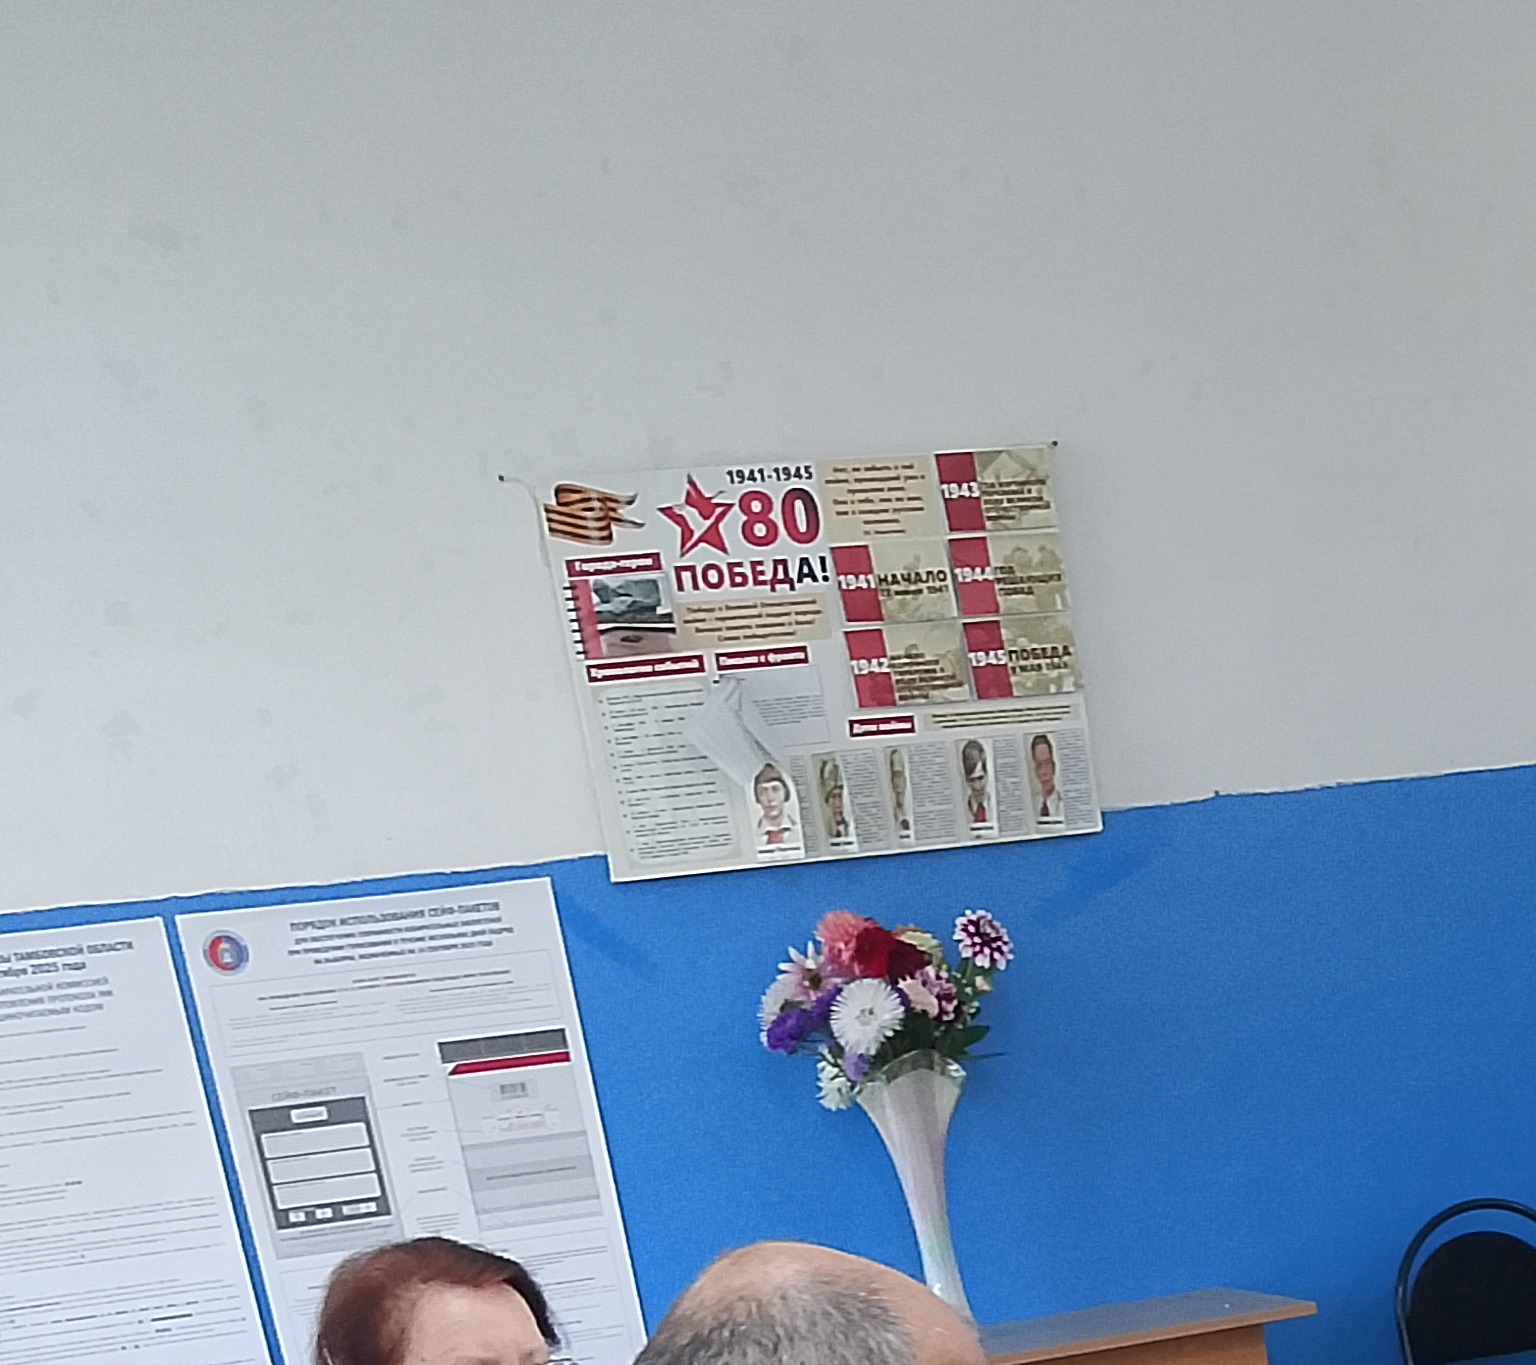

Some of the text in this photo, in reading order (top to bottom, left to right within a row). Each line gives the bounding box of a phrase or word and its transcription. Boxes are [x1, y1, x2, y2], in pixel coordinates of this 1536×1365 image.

[726, 465, 814, 485] 1941-1945
[941, 481, 980, 499] 1943
[738, 487, 821, 547] 80
[674, 556, 830, 593] ПОБЕДА!
[838, 573, 876, 590] 1941
[878, 570, 947, 586] НАЧАЛО
[954, 566, 994, 583] 1944
[968, 650, 1006, 667] 1945
[1008, 645, 1072, 661] ПОБЕДА
[851, 658, 890, 675] 1942
